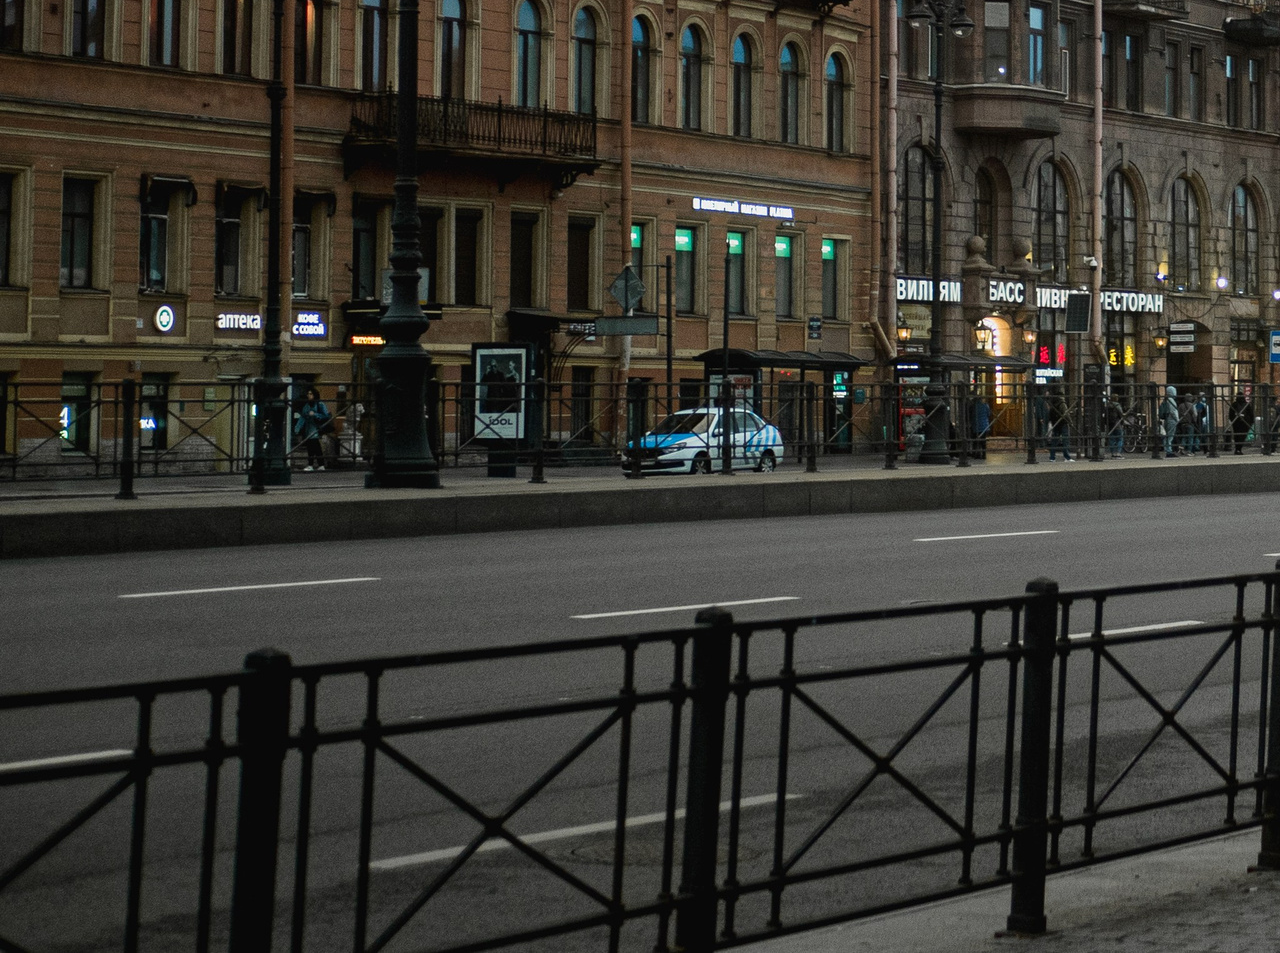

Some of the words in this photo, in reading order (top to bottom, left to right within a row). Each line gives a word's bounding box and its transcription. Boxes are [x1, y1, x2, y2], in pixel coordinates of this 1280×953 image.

[989, 280, 1024, 303] БАСС
[218, 313, 261, 329] аптека
[297, 314, 319, 323] КОФЕ
